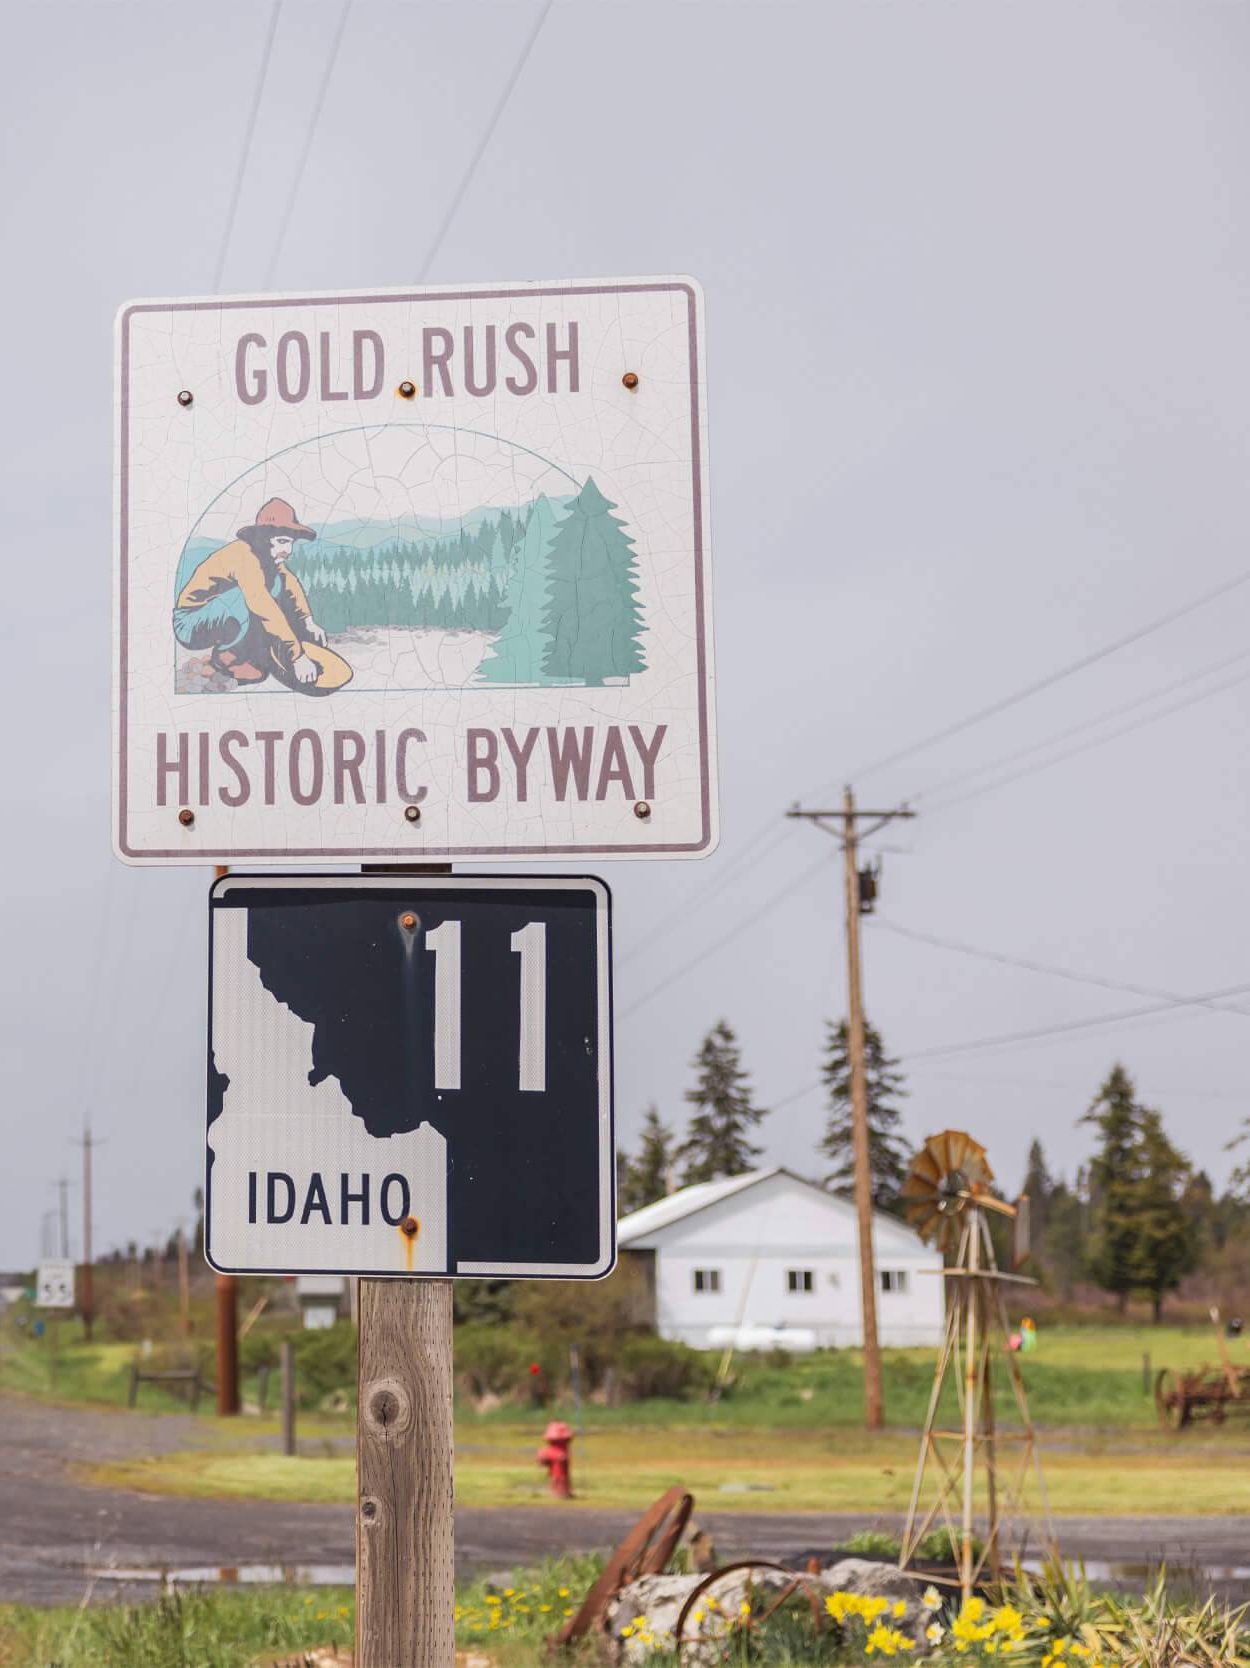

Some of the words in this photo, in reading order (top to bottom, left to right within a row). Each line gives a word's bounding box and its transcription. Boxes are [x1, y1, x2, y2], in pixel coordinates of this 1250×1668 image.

[236, 330, 385, 405] GOLD
[422, 322, 580, 398] RUSH
[157, 728, 428, 806] HISTORIC
[466, 725, 668, 802] BYWAY
[426, 921, 546, 1091] 11
[249, 1172, 410, 1226] IDAHO
